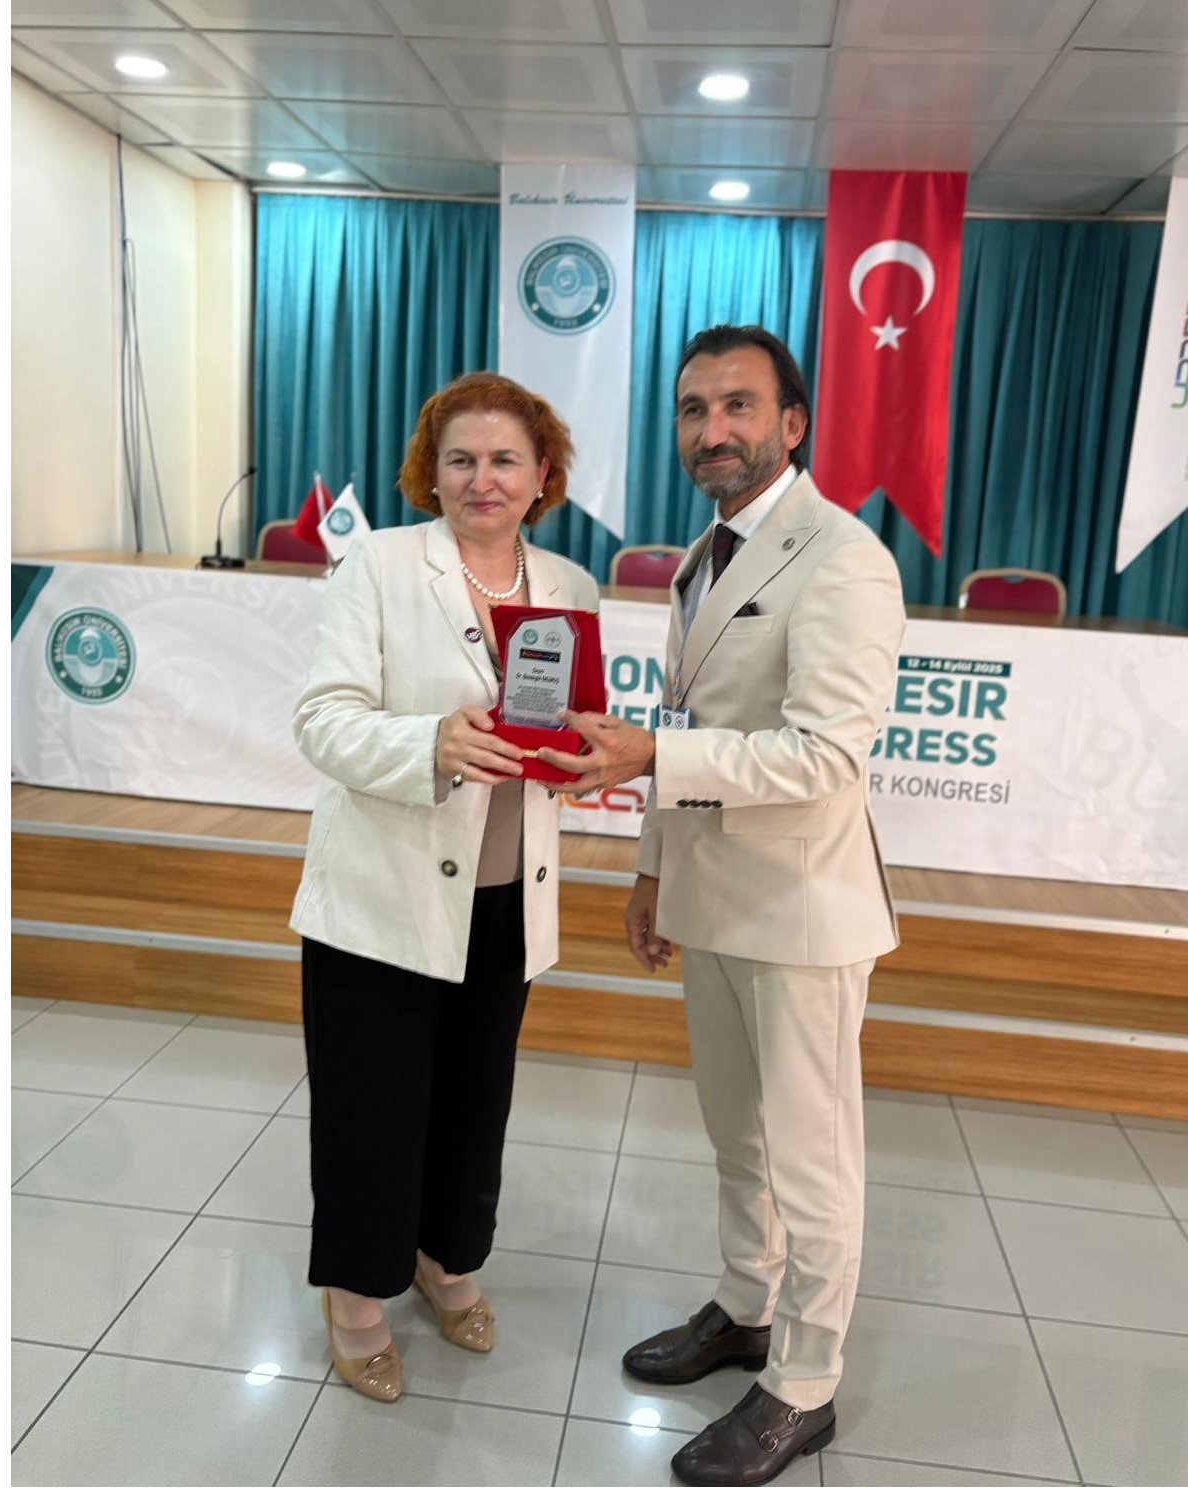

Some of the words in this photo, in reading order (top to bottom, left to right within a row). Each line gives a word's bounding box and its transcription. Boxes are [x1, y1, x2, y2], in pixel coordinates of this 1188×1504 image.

[602, 654, 665, 694] ON
[885, 675, 1008, 721] ESIR
[890, 774, 1012, 805] KONGRESİ
